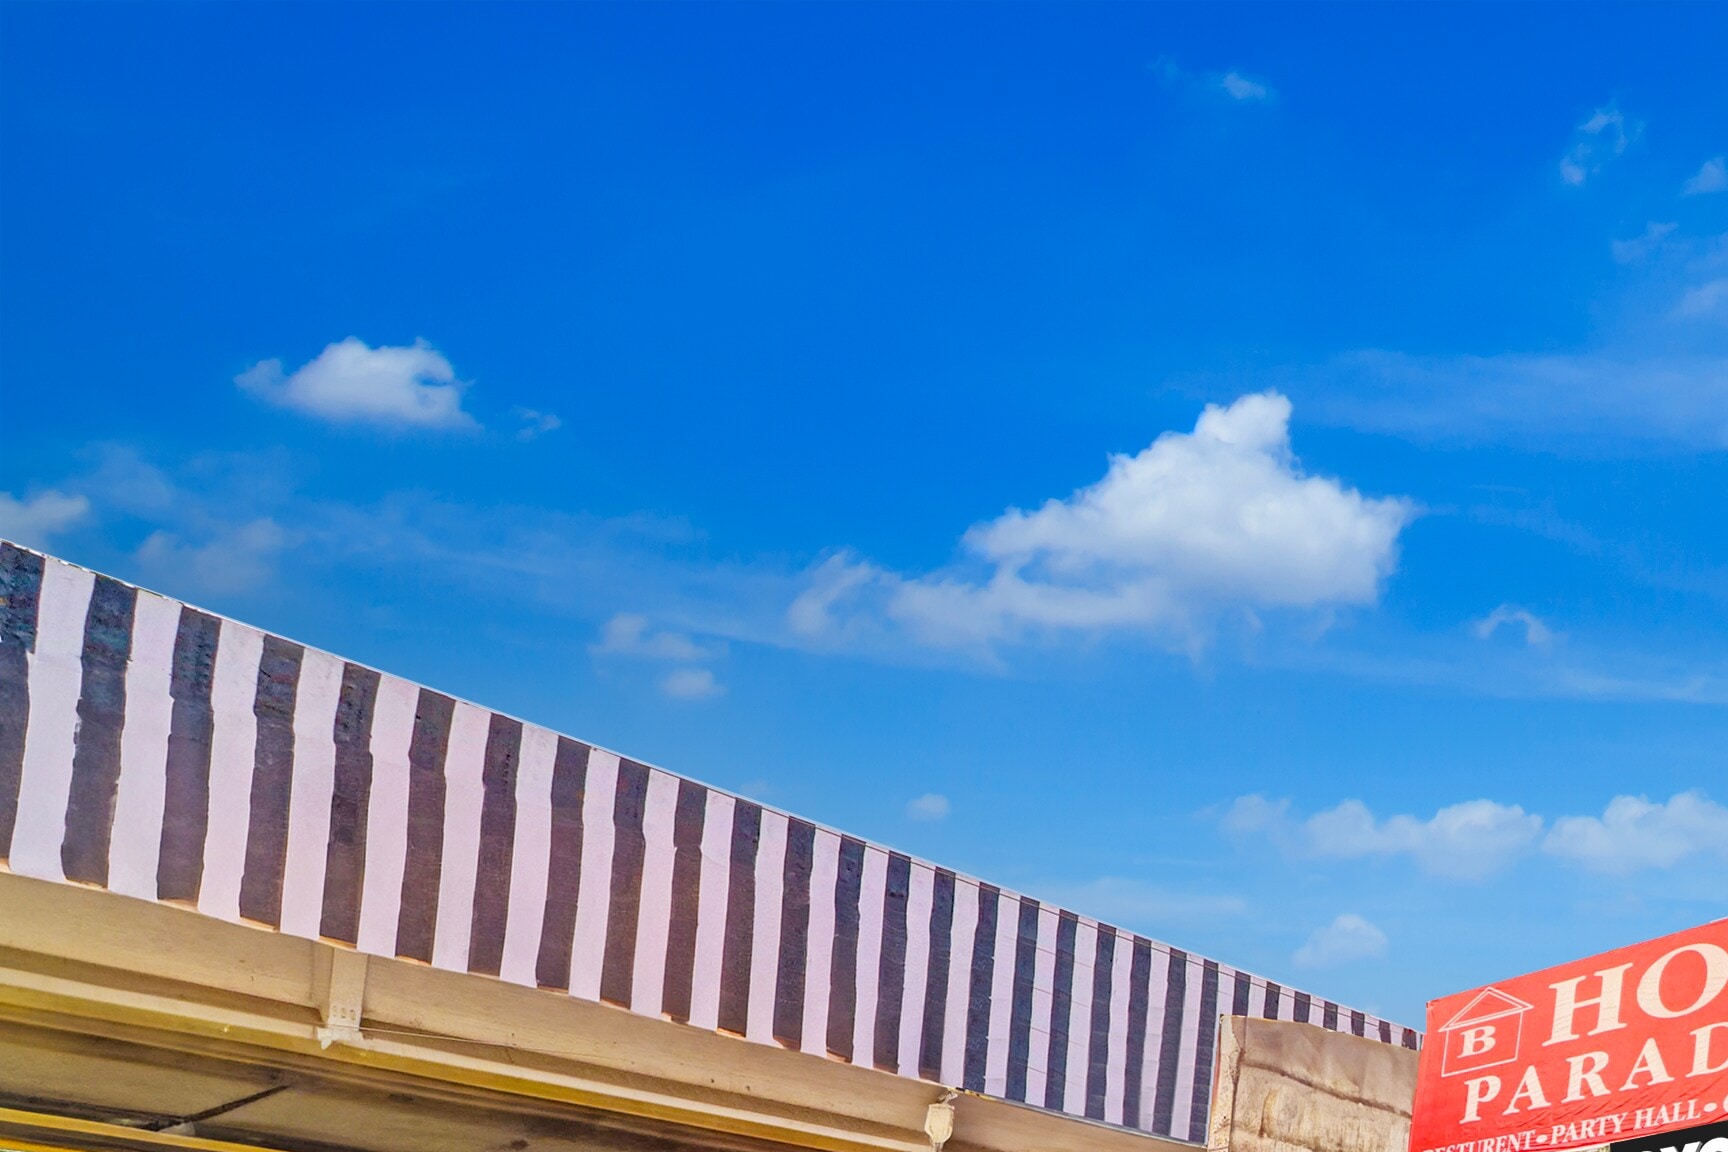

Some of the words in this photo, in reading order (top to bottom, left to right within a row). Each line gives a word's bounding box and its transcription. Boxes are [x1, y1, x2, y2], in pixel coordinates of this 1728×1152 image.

[1457, 1022, 1497, 1059] B
[1549, 1112, 1625, 1146] PARTY
[1632, 1099, 1701, 1132] HALL
